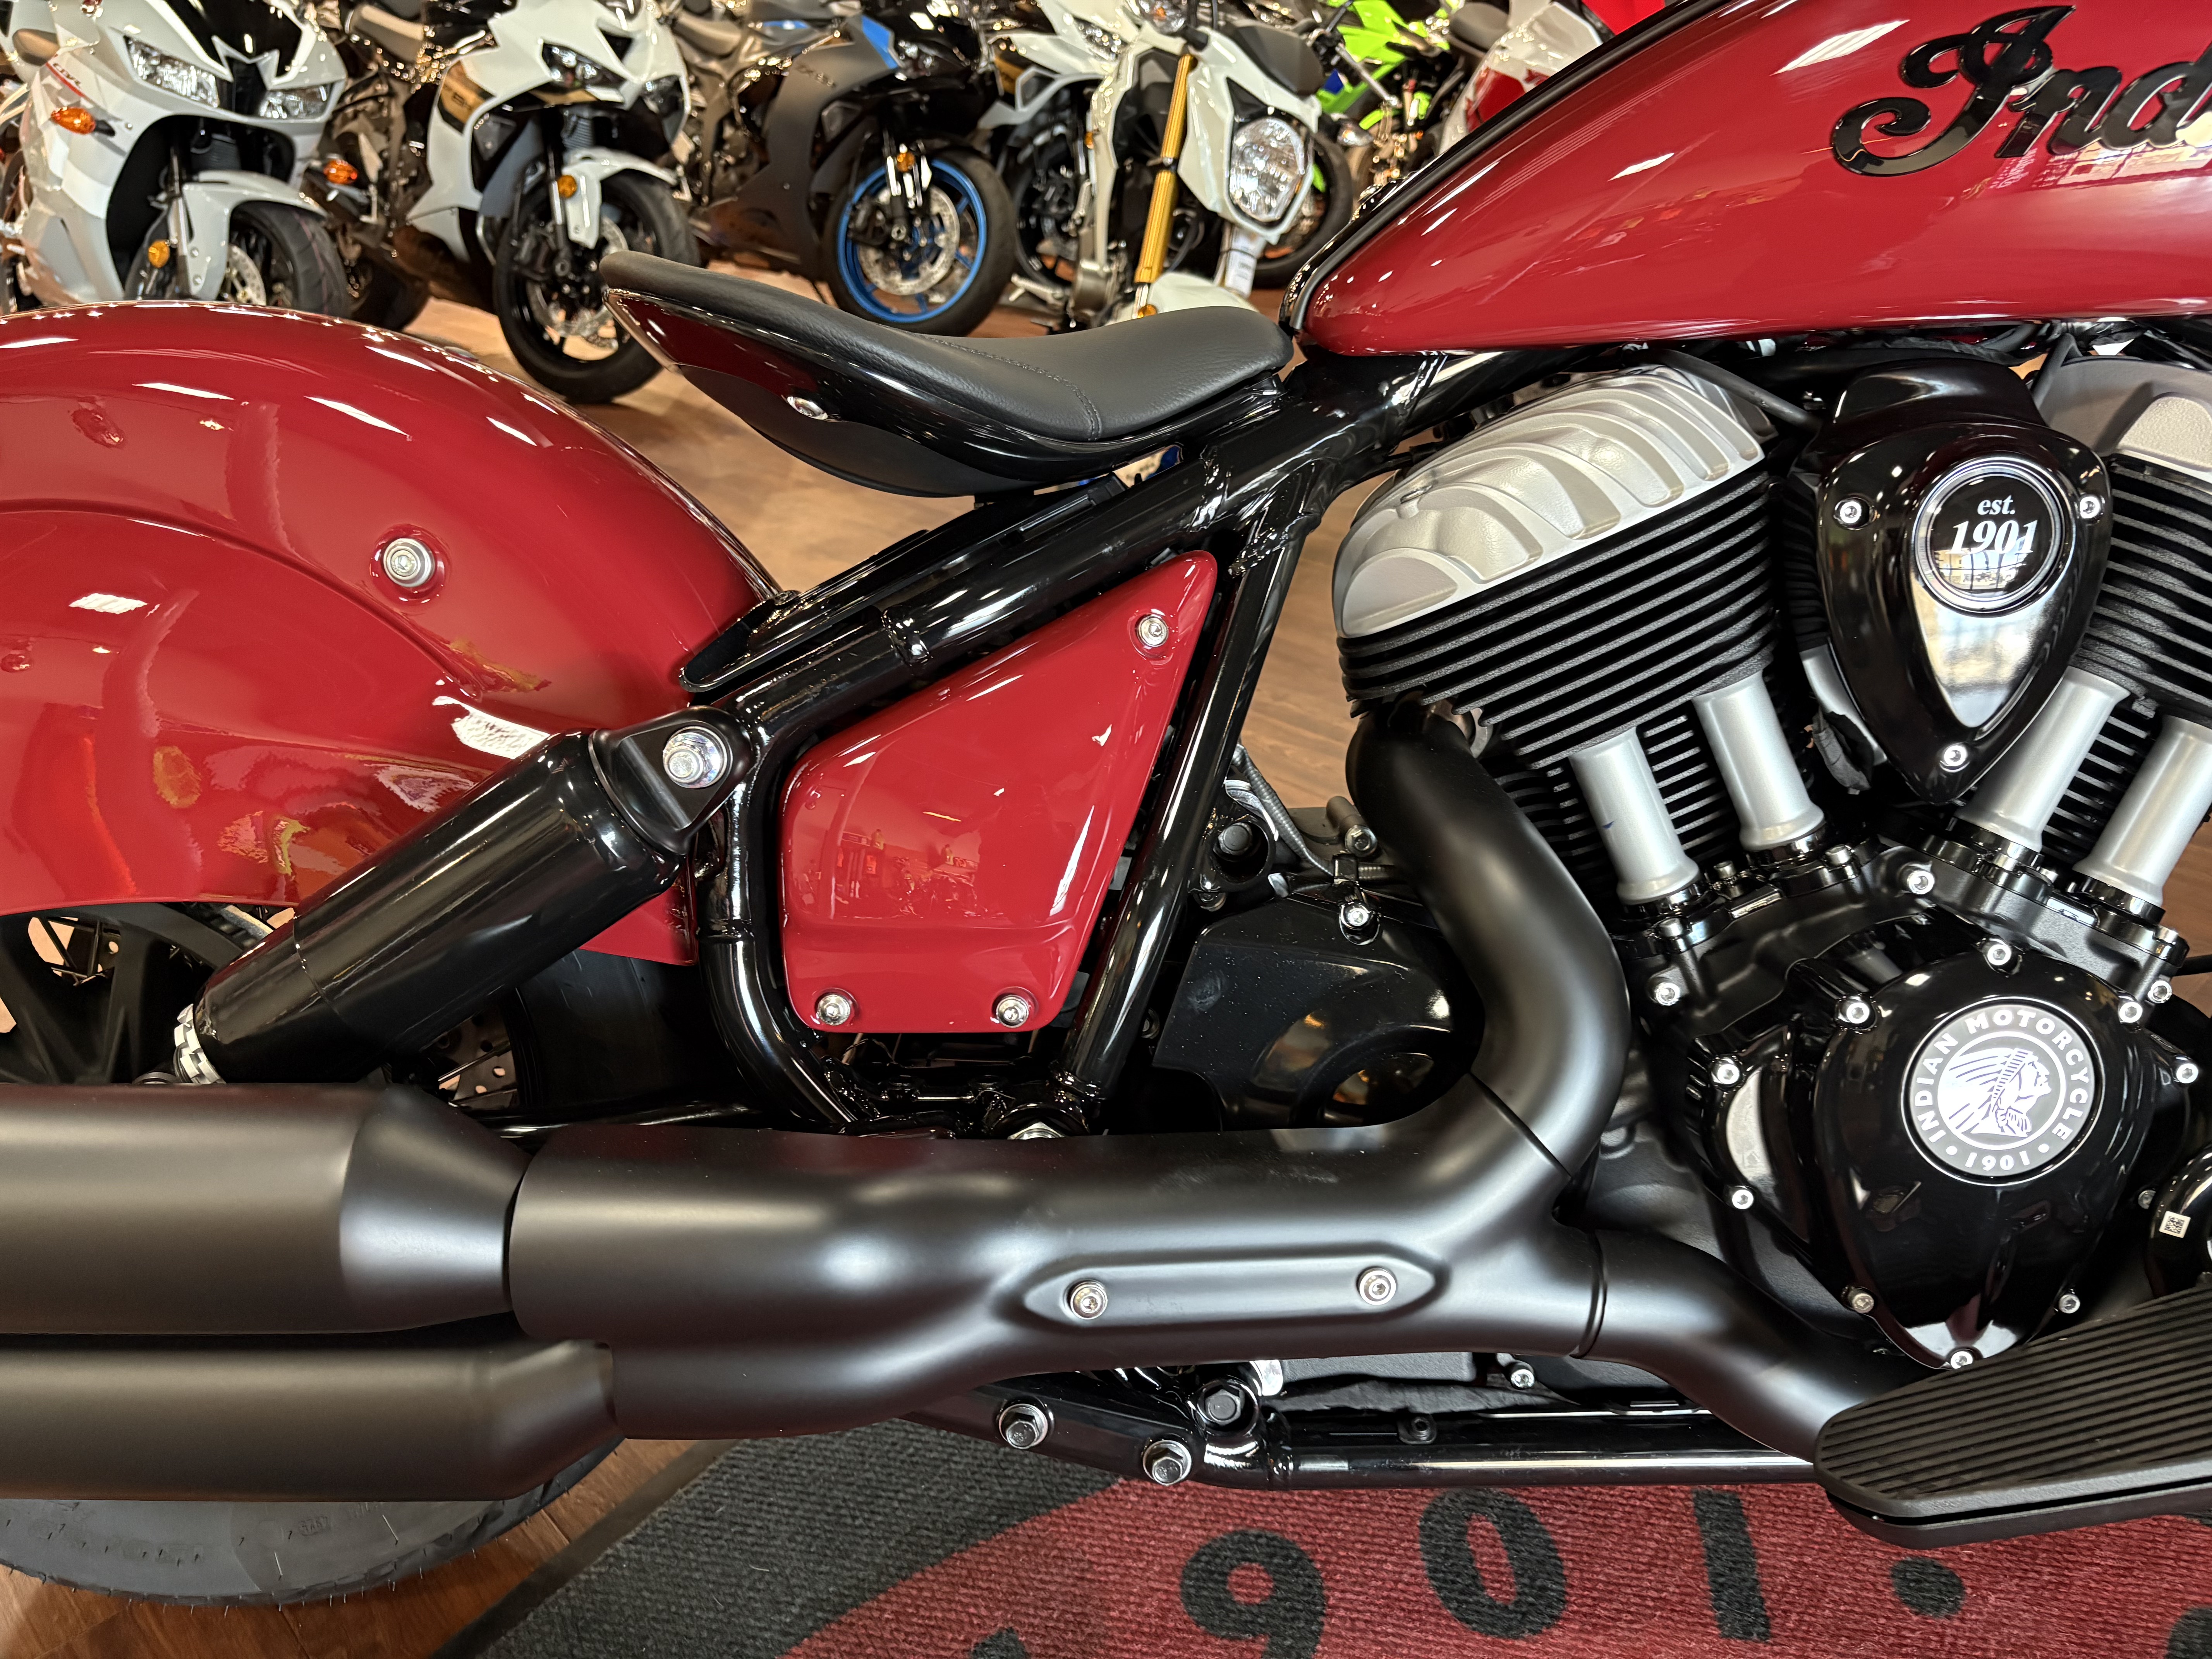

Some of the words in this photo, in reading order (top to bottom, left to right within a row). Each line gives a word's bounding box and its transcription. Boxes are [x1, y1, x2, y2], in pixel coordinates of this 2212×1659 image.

[1977, 495, 2016, 515] est.
[1948, 520, 2038, 555] 1901
[1915, 1034, 1959, 1143] INDIAN
[1964, 1009, 2089, 1141] MOTORCYCLE
[1965, 1151, 2030, 1171] 1901
[969, 1488, 1772, 1659] 901
